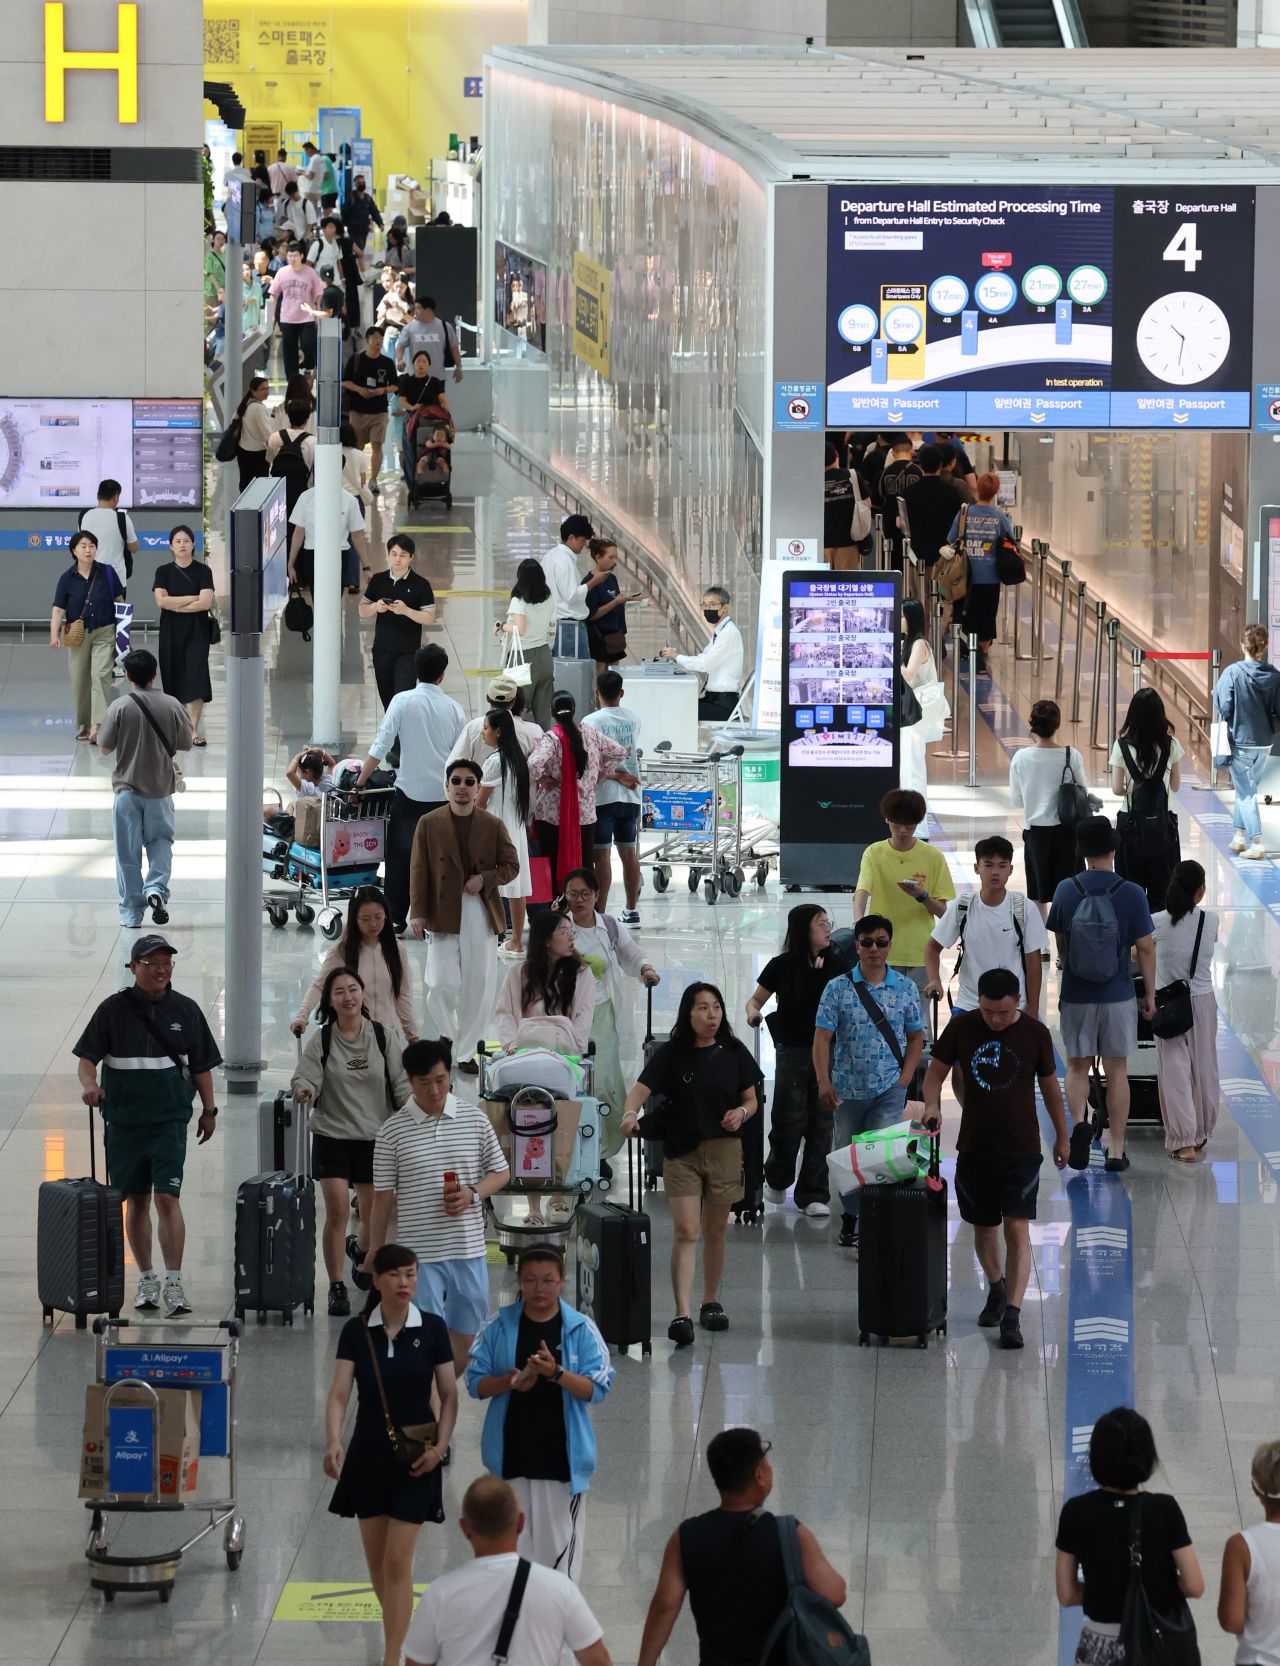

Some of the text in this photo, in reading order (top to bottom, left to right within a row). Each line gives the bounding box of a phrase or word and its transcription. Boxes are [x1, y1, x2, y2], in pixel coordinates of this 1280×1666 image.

[258, 31, 326, 46] 스마트패스
[44, 2, 138, 123] H
[286, 49, 326, 65] 출국장
[841, 200, 1101, 215] Departure Hall Estimated Processing Time
[1132, 200, 1237, 214] 출국장 Departure Hall
[872, 218, 909, 226] Departure
[924, 218, 943, 226] Entry
[952, 218, 981, 226] Security
[1162, 222, 1202, 272] 4
[1028, 280, 1056, 290] 21min
[1073, 280, 1102, 290] 27min
[936, 290, 963, 301] 17min
[983, 287, 1011, 298] 15min
[1060, 309, 1067, 318] 3
[848, 319, 869, 329] 9min
[893, 319, 914, 329] 5min
[965, 320, 974, 329] 4
[875, 348, 883, 357] 5
[1045, 378, 1103, 389] In test operation
[852, 398, 939, 410] 일반여권 Passport
[994, 398, 1082, 410] 일반여권 Passport
[1137, 398, 1225, 410] 일반여권 Passport
[45, 536, 71, 546] 공항안
[967, 540, 982, 548] DAY
[809, 584, 874, 592] 출국장별 대기열 상황
